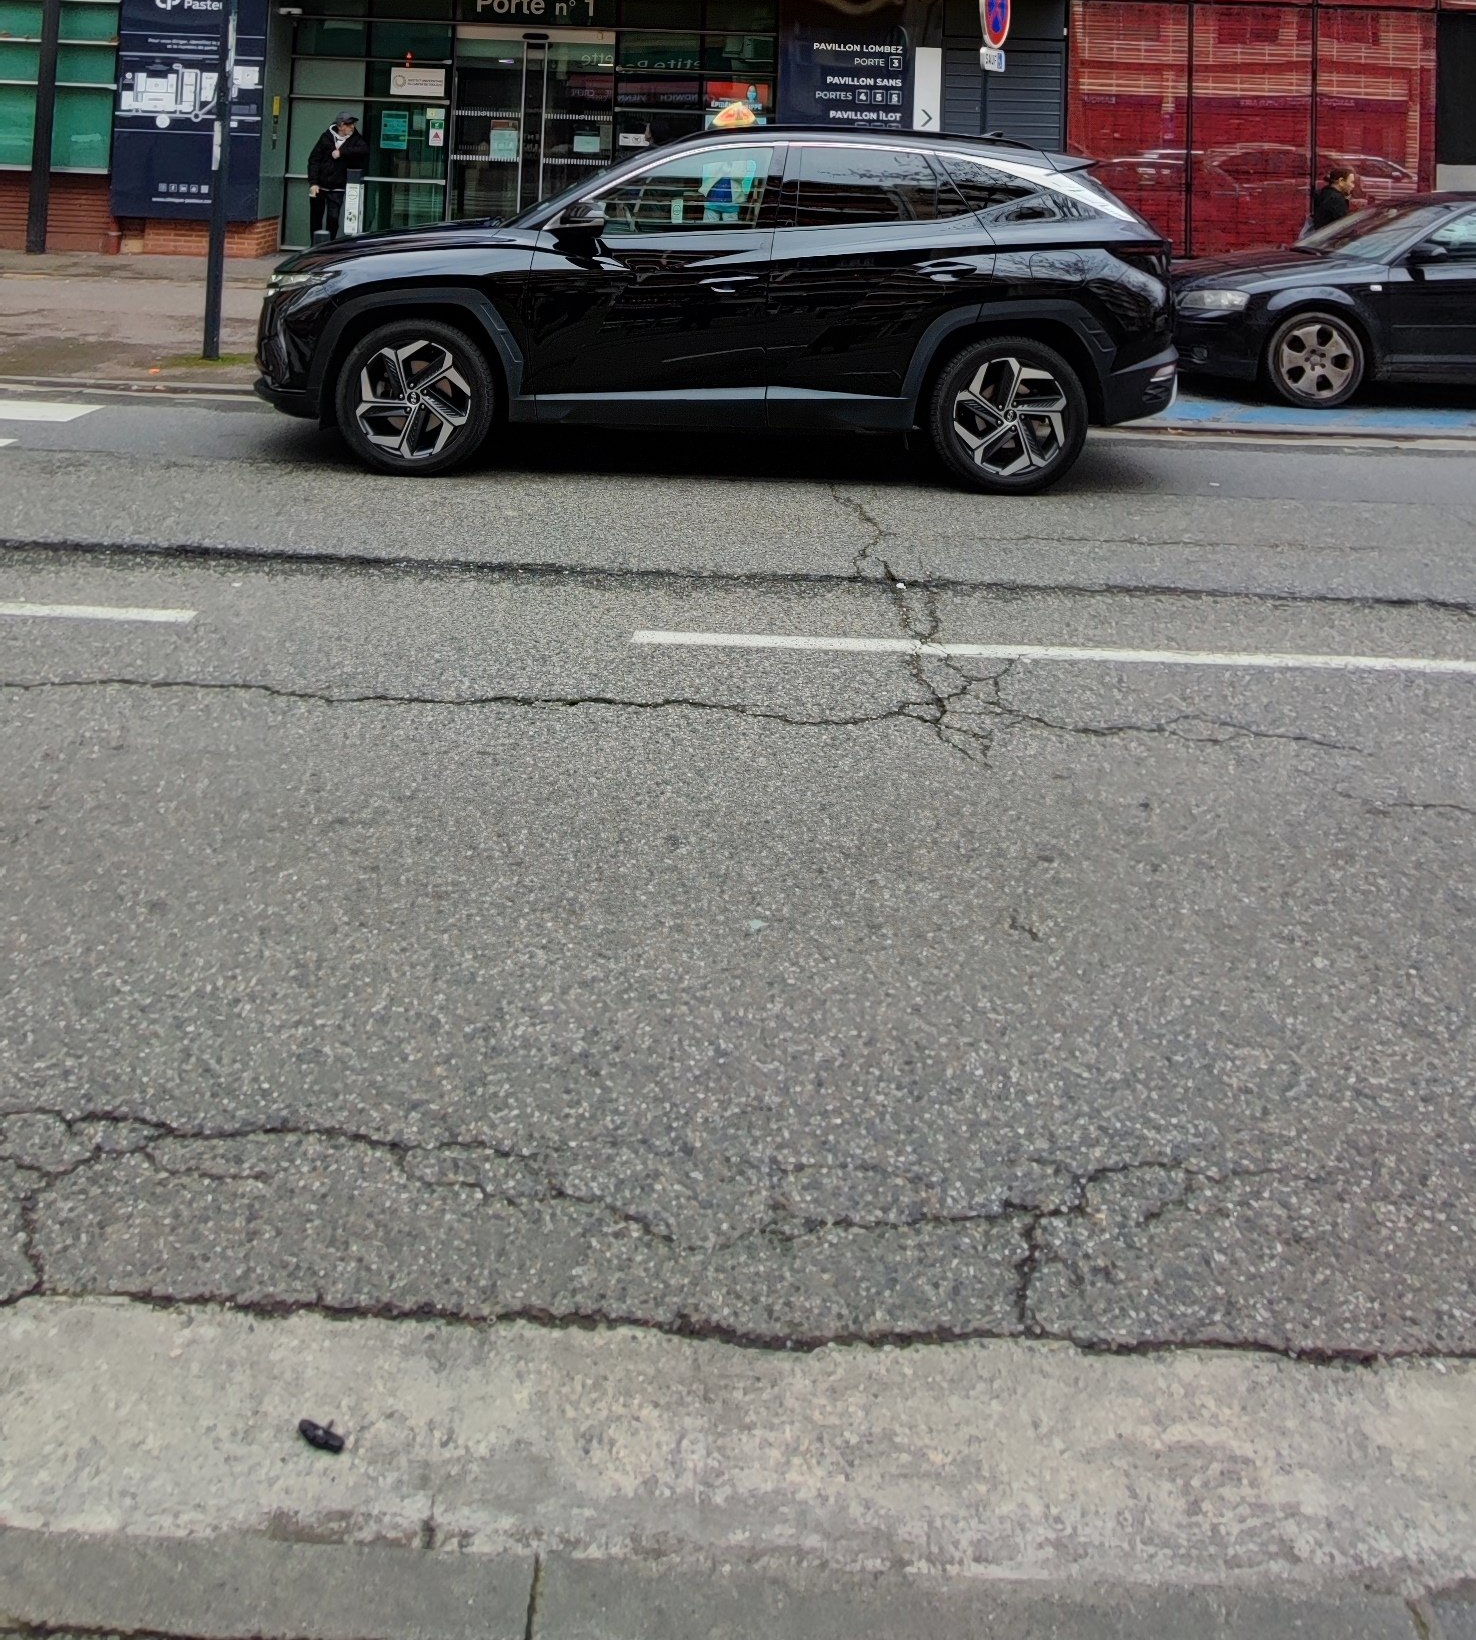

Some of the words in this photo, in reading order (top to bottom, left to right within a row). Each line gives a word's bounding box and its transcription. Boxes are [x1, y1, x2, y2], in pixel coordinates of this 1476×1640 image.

[813, 42, 860, 52] PAVILLON
[863, 44, 903, 54] LOMBEZ
[854, 57, 885, 66] PORTE
[826, 76, 874, 86] PAVILLON
[876, 78, 902, 87] SANS
[815, 91, 852, 100] PORTES
[829, 110, 877, 120] PAVILLON
